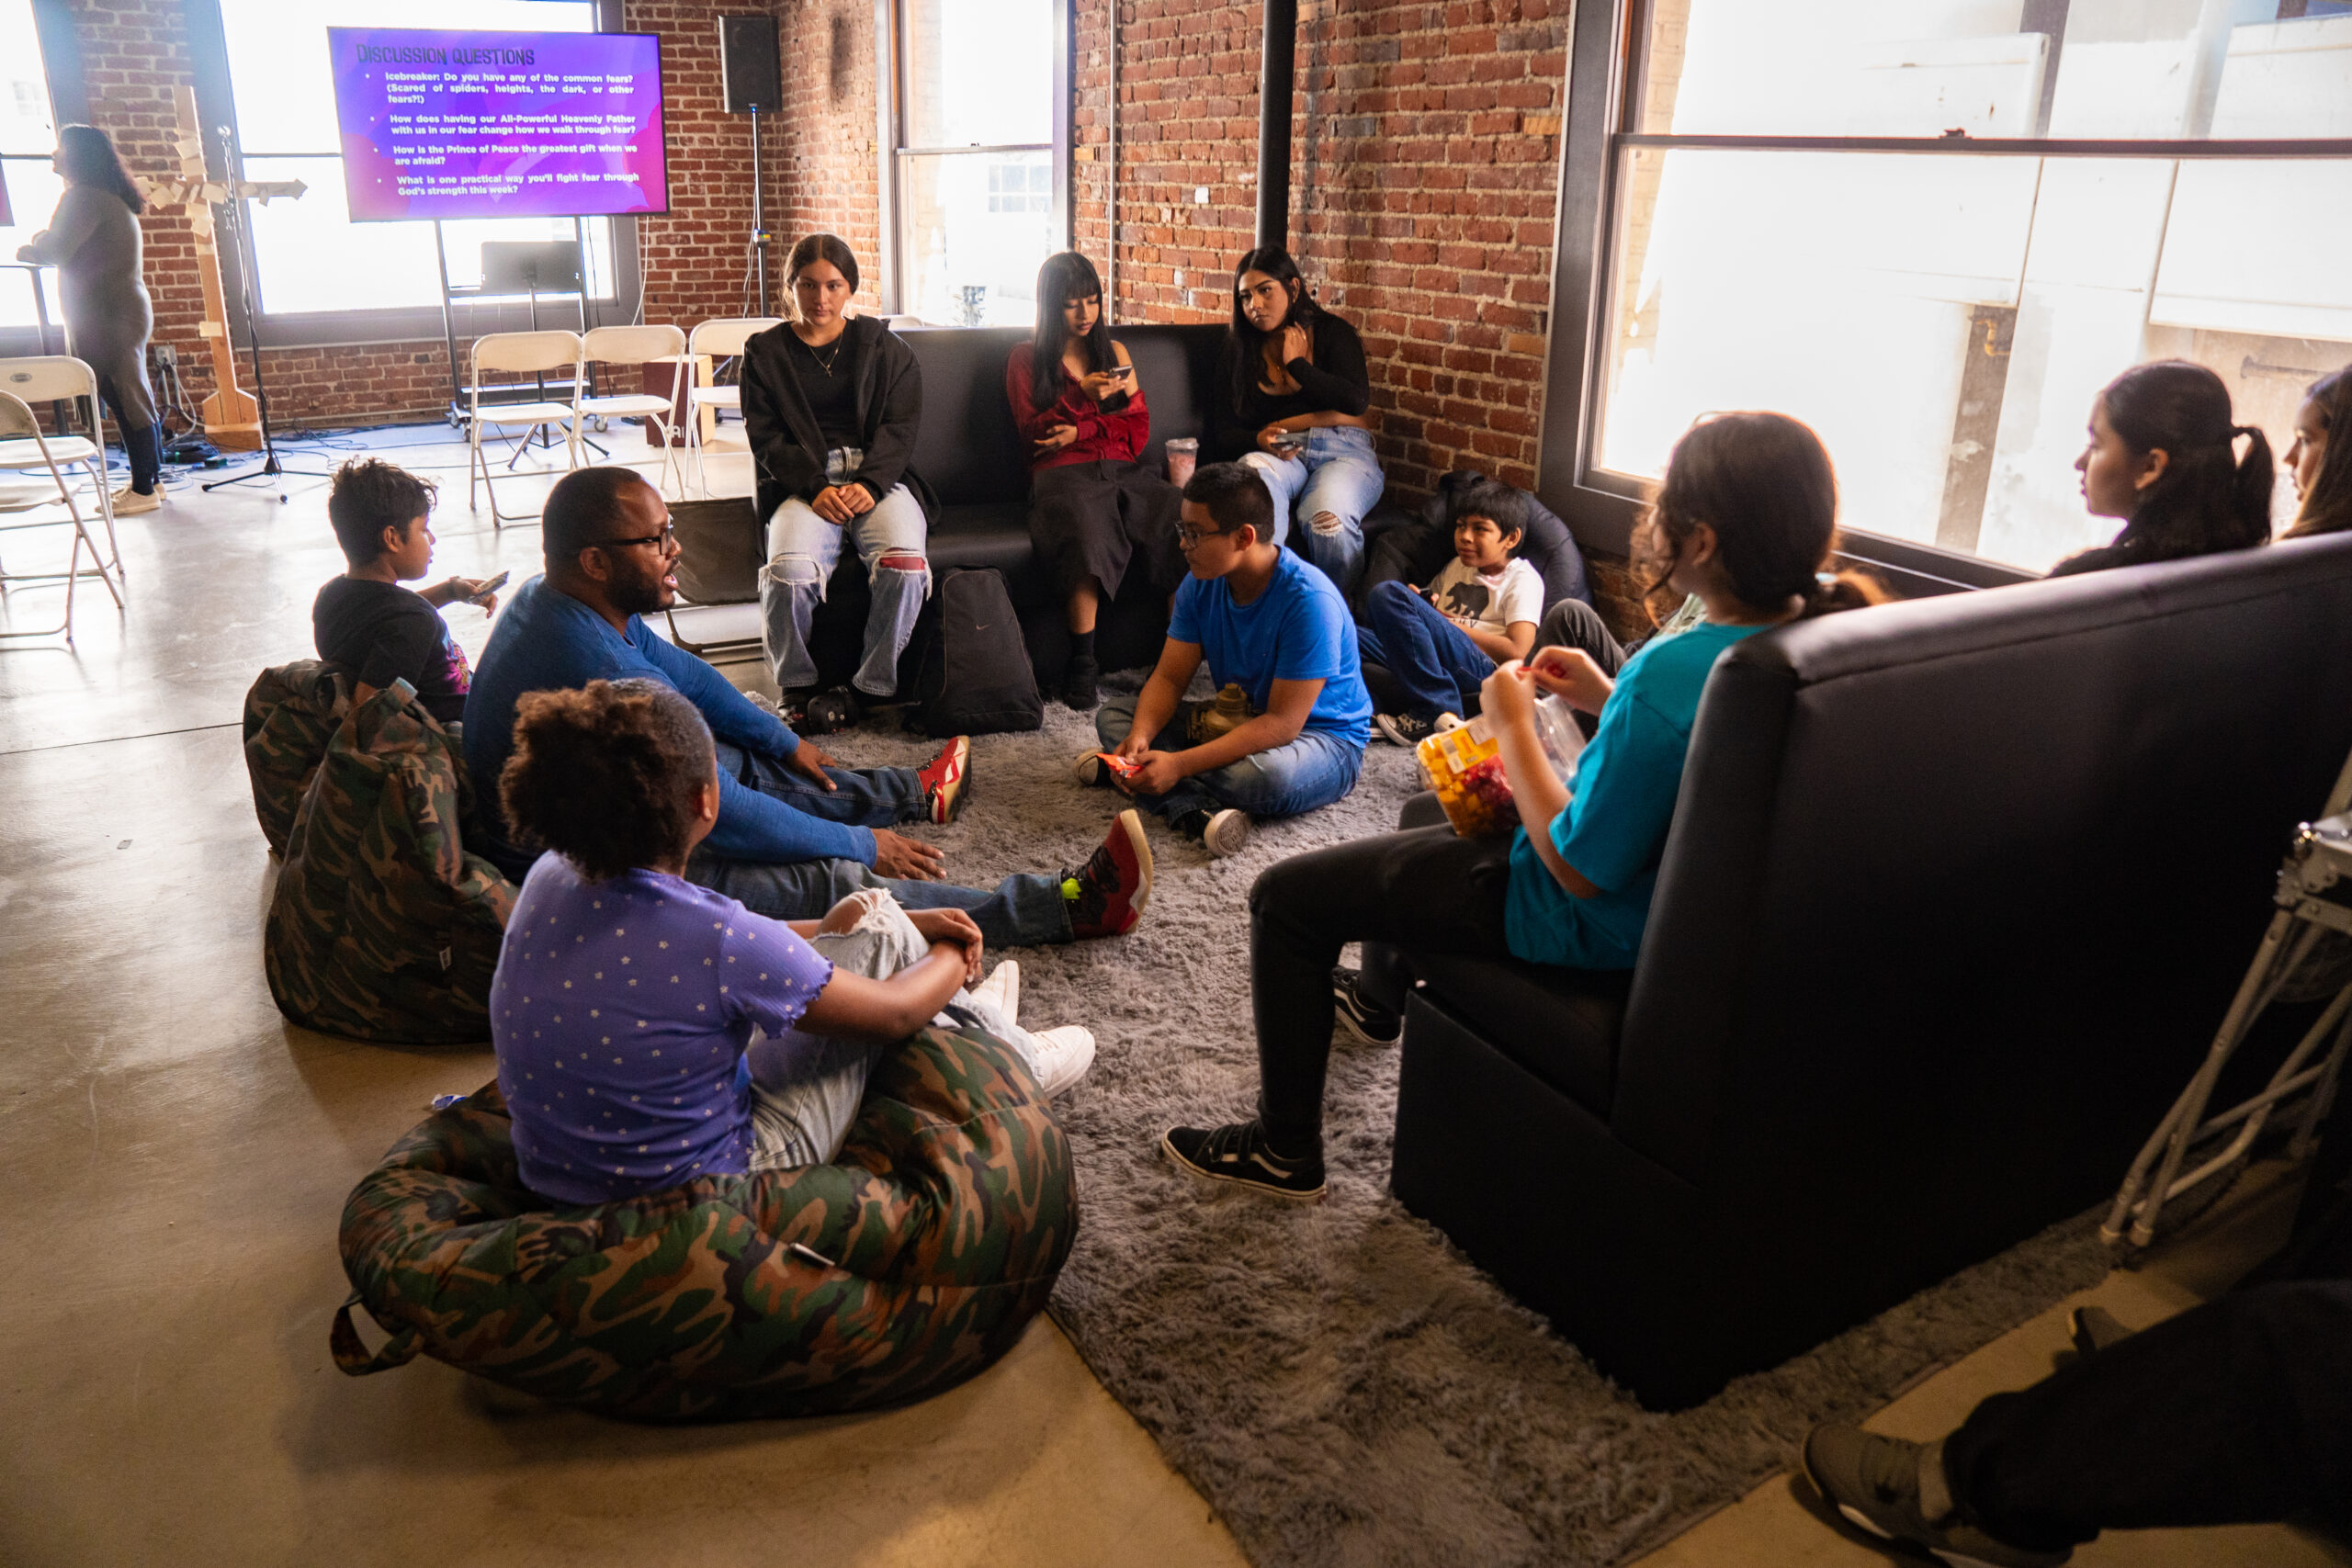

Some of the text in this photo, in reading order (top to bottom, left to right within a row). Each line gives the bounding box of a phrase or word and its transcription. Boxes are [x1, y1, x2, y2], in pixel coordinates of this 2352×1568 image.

[356, 44, 535, 66] DISCUSSION QUESTIONS
[385, 72, 440, 81] Icebreaker:
[444, 73, 458, 82] Do
[461, 74, 480, 83] you
[483, 73, 506, 82] have
[509, 74, 526, 84] any
[530, 73, 540, 82] of
[544, 73, 560, 83] the
[606, 74, 633, 84] fears?
[387, 84, 426, 93] (Scared
[433, 84, 444, 93] of
[450, 84, 489, 95] spiders,
[494, 84, 534, 95] heights,
[540, 85, 556, 93] the
[562, 85, 586, 95] dark,
[609, 85, 634, 94] other
[390, 115, 412, 123] How
[416, 115, 440, 123] does
[444, 114, 477, 125] having
[500, 114, 558, 123] All-Powerful
[561, 115, 603, 125] Heavenly
[606, 115, 636, 123] Father
[391, 126, 413, 135] with
[428, 126, 438, 134] in
[458, 125, 478, 134] fear
[479, 125, 514, 136] change
[515, 125, 536, 134] how
[552, 125, 574, 134] walk
[575, 125, 612, 135] through
[613, 125, 636, 134] fear?
[393, 146, 415, 154] How
[417, 145, 426, 154] is
[428, 145, 445, 153] the
[447, 145, 477, 153] Prince
[479, 144, 490, 153] of
[492, 145, 520, 153] Peace
[521, 144, 537, 153] the
[539, 144, 578, 154] greatest
[580, 144, 596, 154] gift
[598, 144, 623, 152] when
[413, 156, 446, 165] afraid?
[397, 176, 424, 185] What
[426, 175, 435, 185] is
[461, 175, 502, 186] practical
[505, 175, 524, 186] way
[527, 174, 553, 184] you'll
[556, 174, 579, 184] fight
[582, 173, 601, 182] fear
[604, 173, 639, 183] through
[398, 186, 518, 196] God's strength this week?
